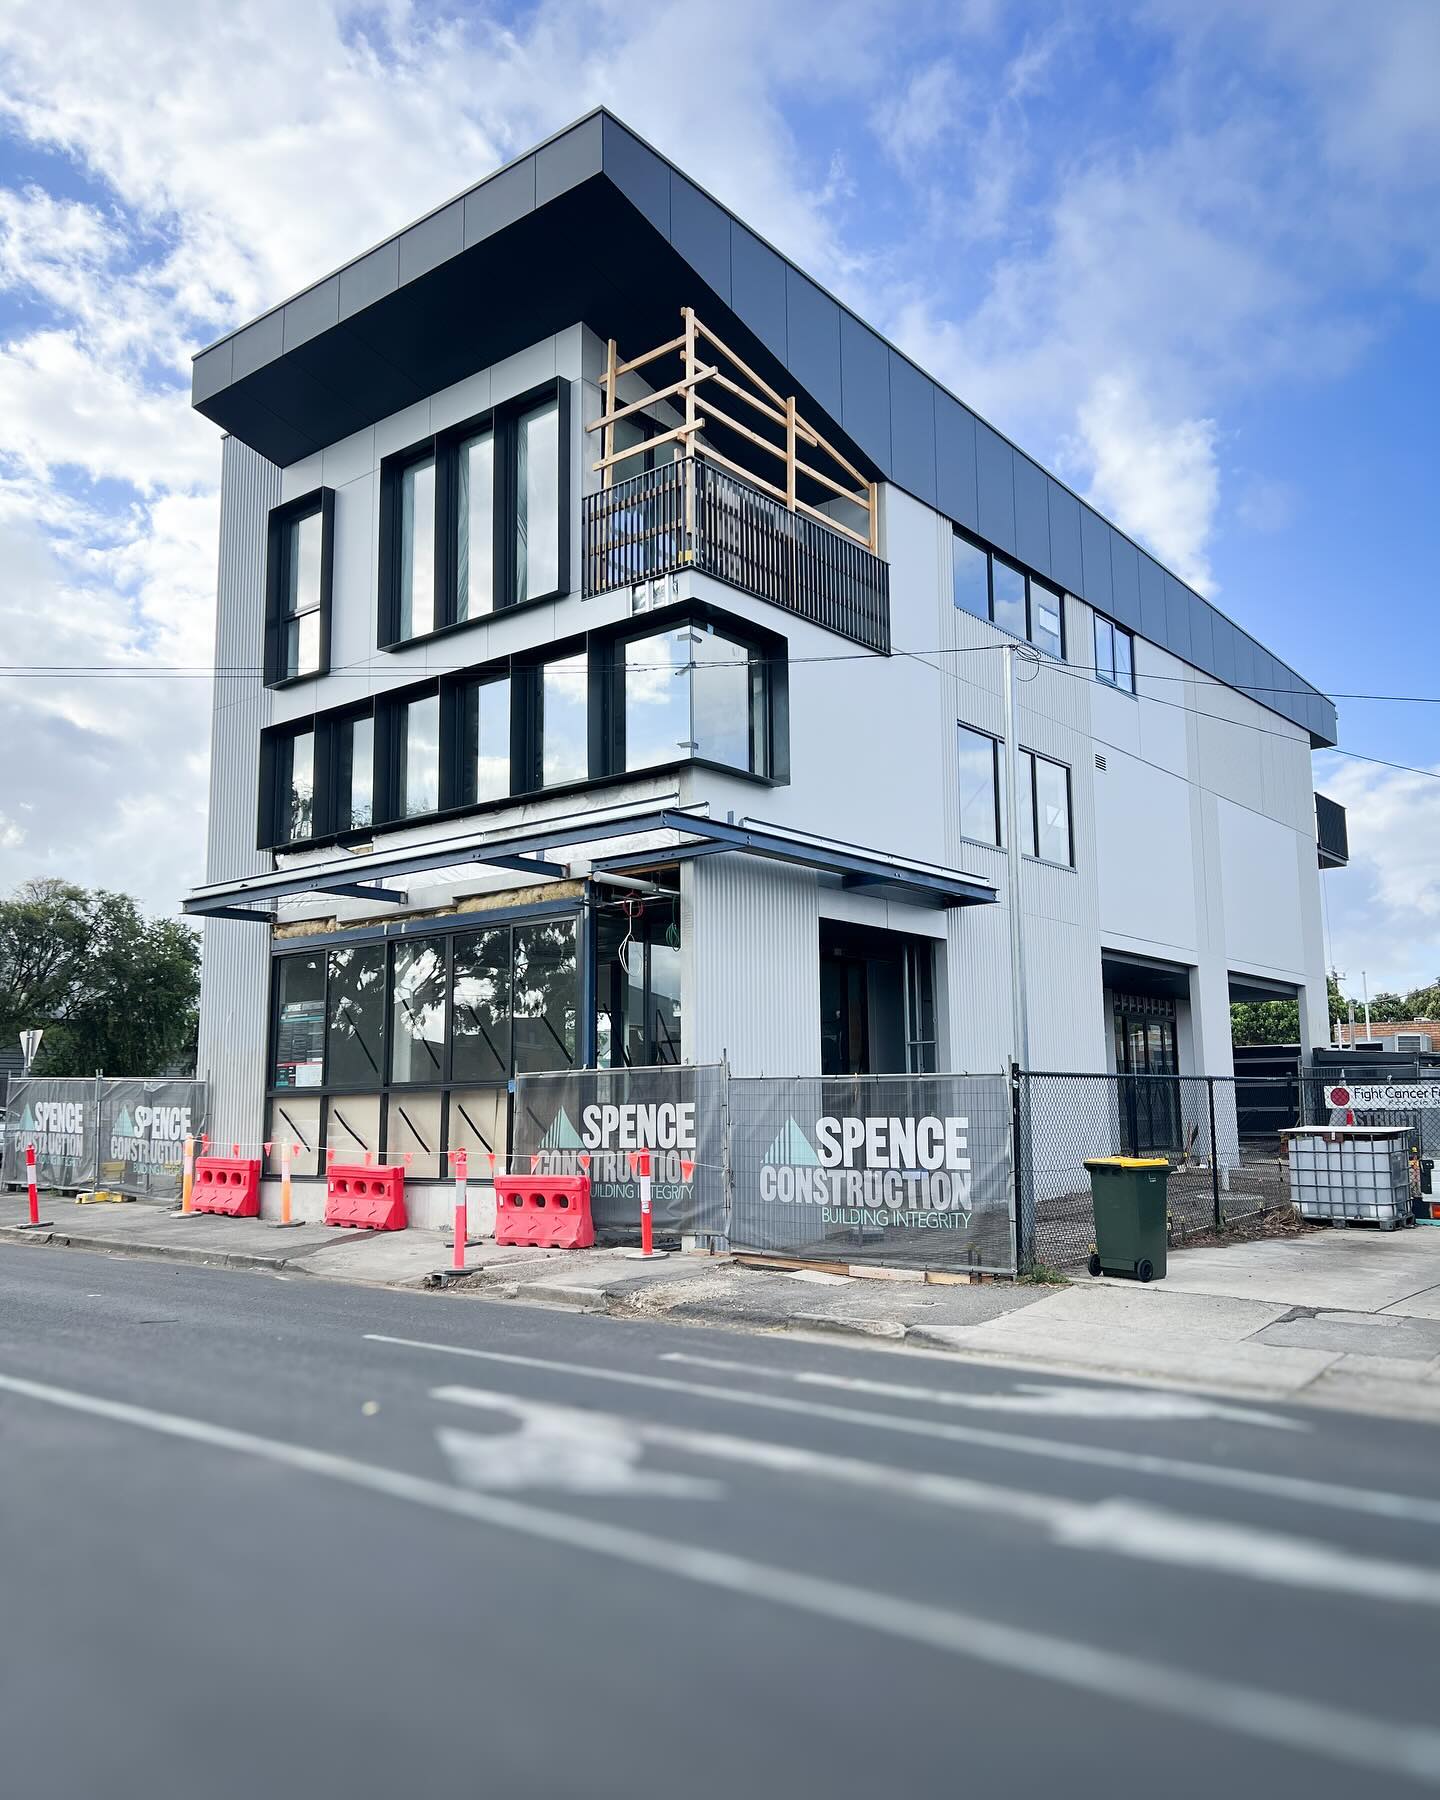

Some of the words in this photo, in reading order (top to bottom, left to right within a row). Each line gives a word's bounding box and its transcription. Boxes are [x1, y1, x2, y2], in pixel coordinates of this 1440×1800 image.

[1354, 1087, 1382, 1101] Fight
[1385, 1086, 1428, 1099] Cancer
[35, 1101, 83, 1134] SPENCE
[134, 1105, 192, 1140] SPENCE
[582, 1102, 696, 1149] SPENCE
[111, 1136, 186, 1165] CONSTRUCTIO
[816, 1116, 971, 1170] SPENCE
[590, 1183, 634, 1199] UILDING
[637, 1184, 695, 1200] ITEGRITY
[760, 1165, 972, 1211] CONSTRUCTION
[821, 1206, 889, 1227] BUILDING
[893, 1210, 973, 1229] INTEGRITY
